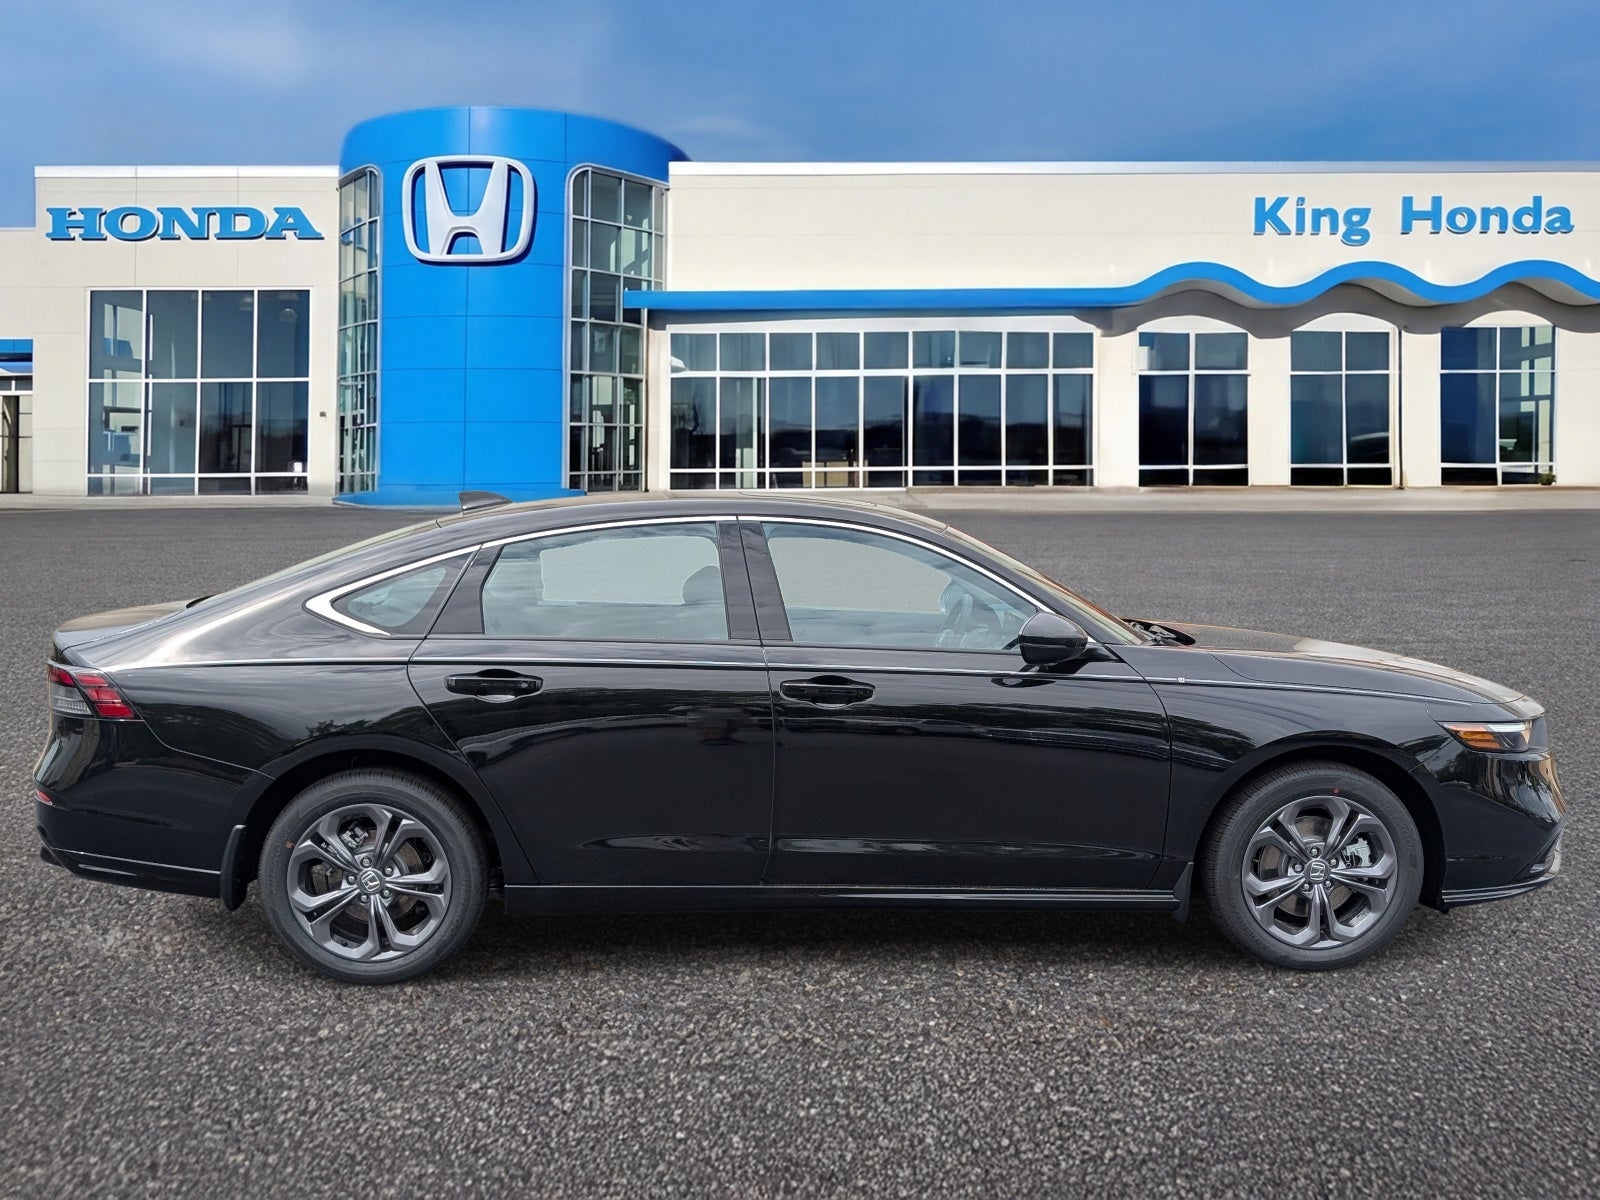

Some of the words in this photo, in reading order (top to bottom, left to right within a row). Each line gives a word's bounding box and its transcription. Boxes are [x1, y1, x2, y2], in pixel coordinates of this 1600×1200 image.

[46, 206, 324, 241] HONDA
[1253, 196, 1372, 246] King
[1400, 195, 1575, 235] Honda
